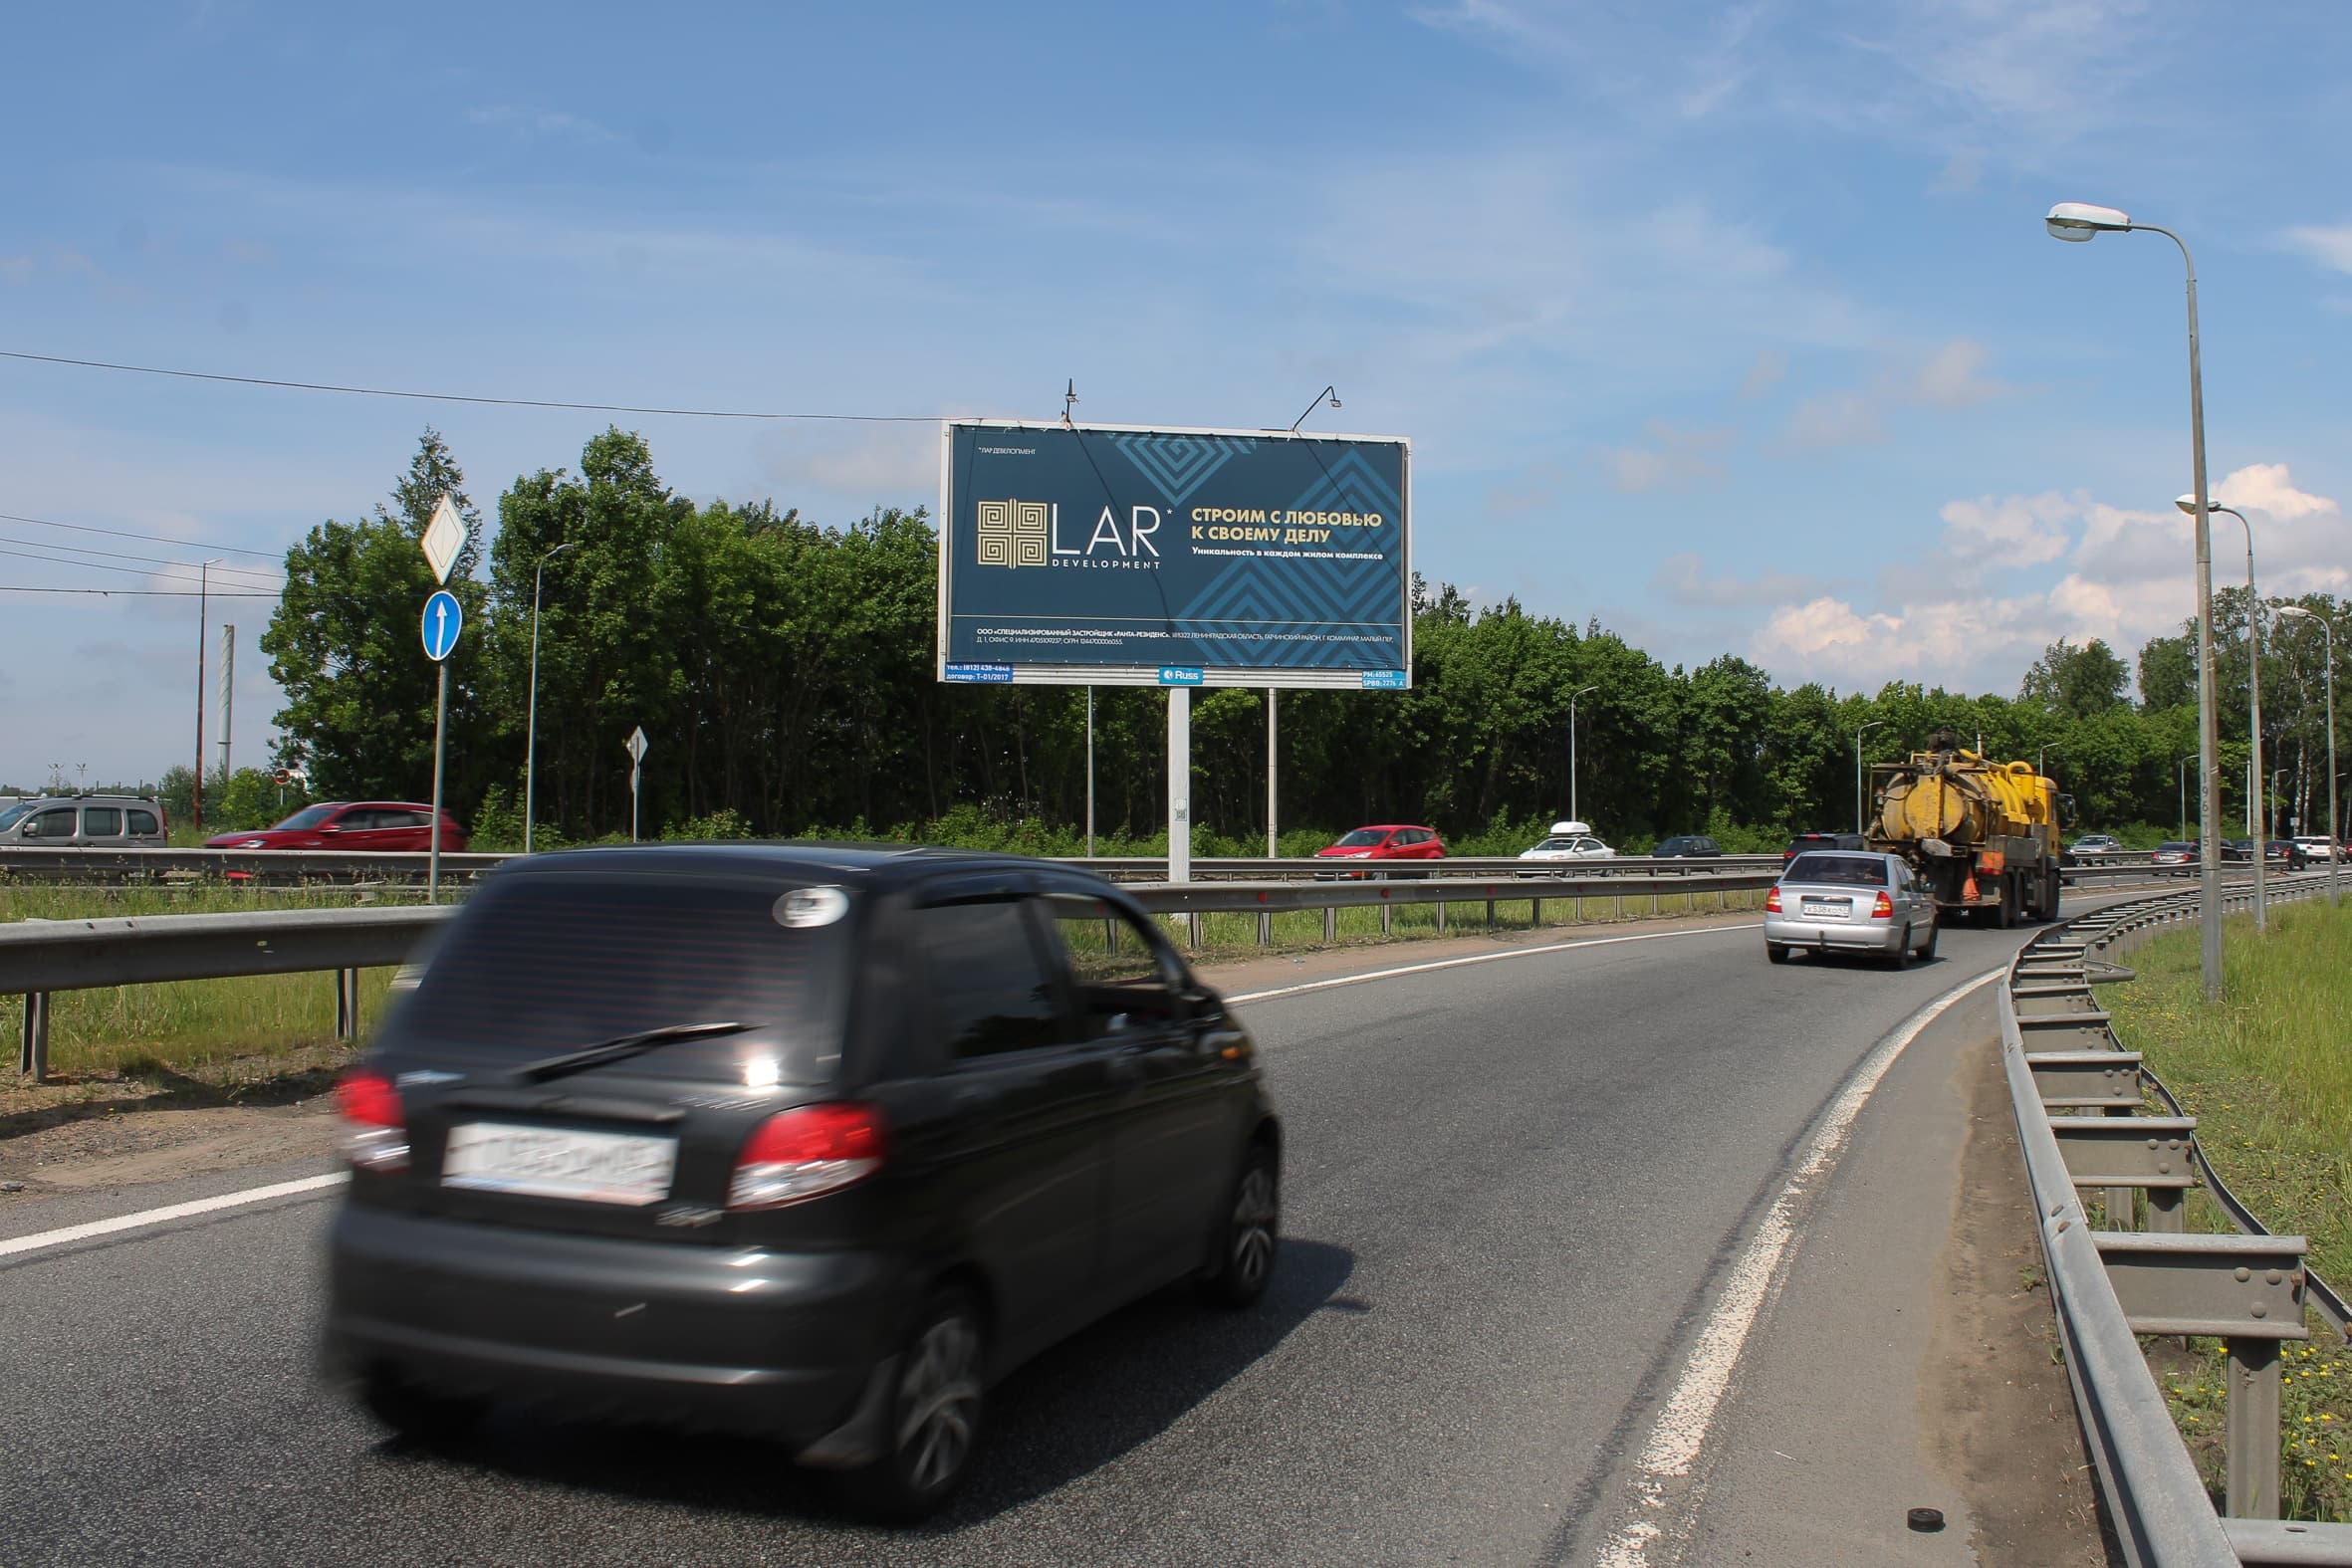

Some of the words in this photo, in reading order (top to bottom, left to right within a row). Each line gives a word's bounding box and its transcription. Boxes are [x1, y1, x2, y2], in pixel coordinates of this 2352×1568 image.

[1191, 508, 1266, 524] СТРОИМ
[1270, 510, 1282, 524] С
[1284, 511, 1382, 527] ЛЮБОВЬЮ
[1191, 526, 1203, 540] К
[1208, 526, 1281, 542] СВОЕМУ
[1284, 529, 1330, 545] ДЕЛУ
[1192, 547, 1255, 557] Уникальность
[1335, 552, 1383, 560] комплексе
[1052, 559, 1161, 569] DEVELOPMENT
[1175, 670, 1198, 680] Russ
